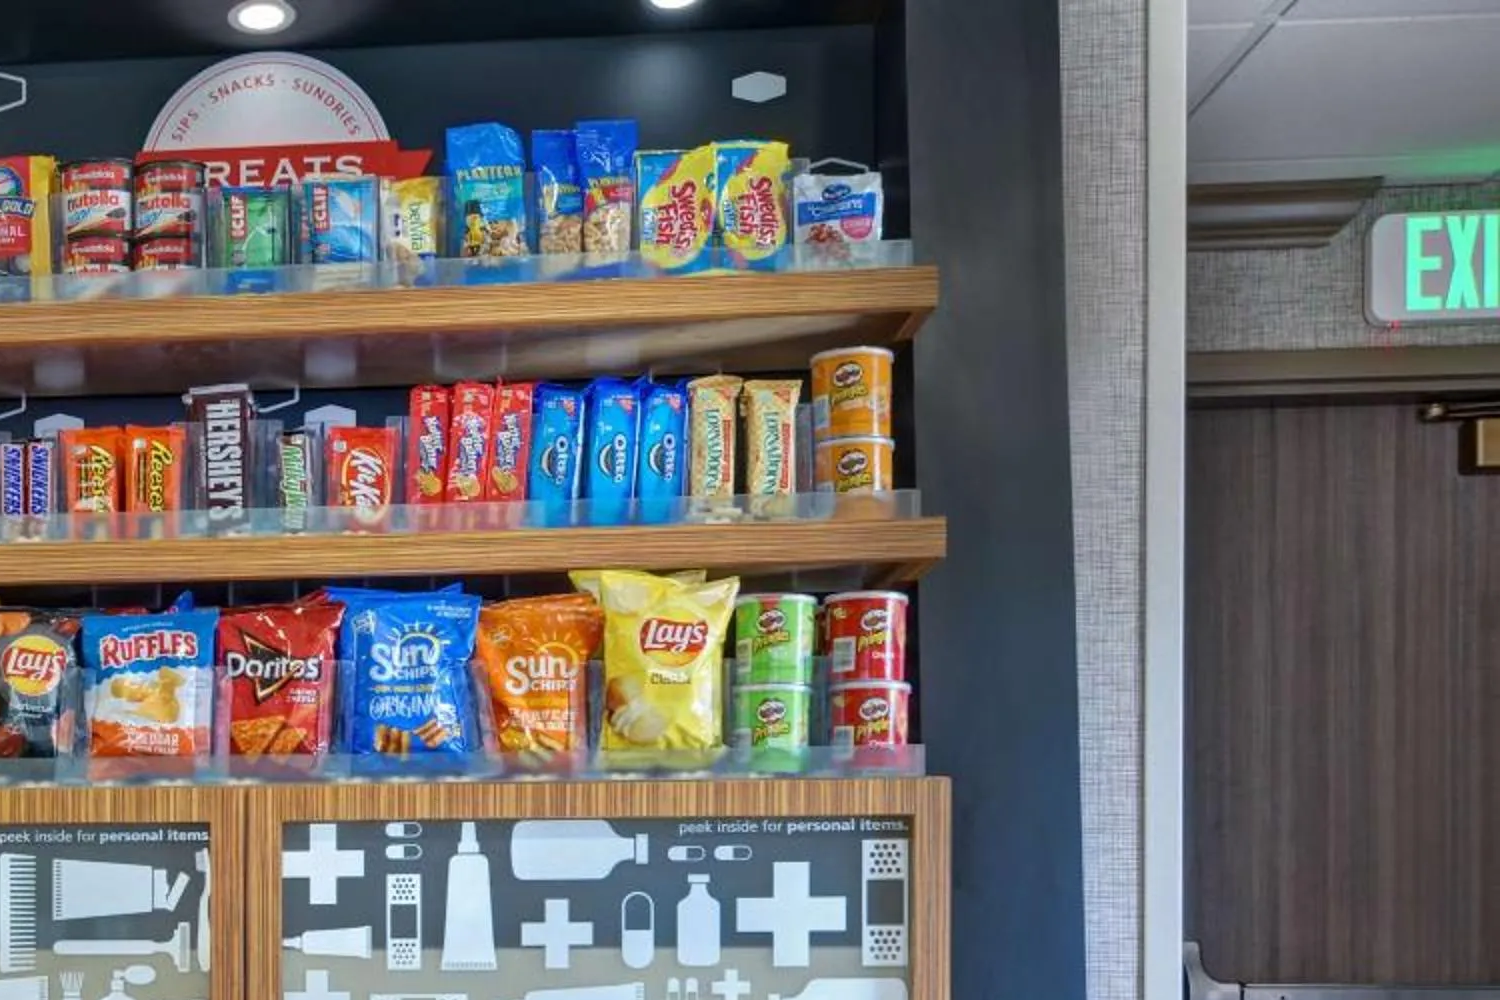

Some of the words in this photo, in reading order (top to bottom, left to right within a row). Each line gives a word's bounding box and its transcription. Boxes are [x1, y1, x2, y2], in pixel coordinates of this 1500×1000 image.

[171, 111, 199, 142] SIPS
[209, 73, 276, 104] SNACKS
[292, 77, 361, 136] SUNDRIES
[204, 155, 366, 189] REATS
[656, 203, 677, 246] Fish
[738, 194, 756, 236] Fish
[1405, 214, 1500, 311] EXI
[3, 447, 21, 515] SNICKERS
[30, 446, 49, 515] SNICKERS
[205, 403, 243, 521] HERSHEY'S
[101, 630, 198, 669] RUFFLES
[643, 620, 707, 652] Lay's
[7, 647, 66, 682] Lay's
[226, 652, 321, 680] Doritos
[370, 641, 440, 682] Sun
[505, 654, 578, 695] Sun
[529, 679, 577, 691] CHIPS
[0, 830, 31, 844] peek
[35, 829, 73, 843] inside
[77, 830, 96, 843] for
[99, 829, 164, 845] personal
[678, 821, 713, 836] peek
[717, 819, 759, 833] inside
[762, 819, 783, 833] for
[786, 818, 855, 836] personal
[859, 817, 909, 831] items.
